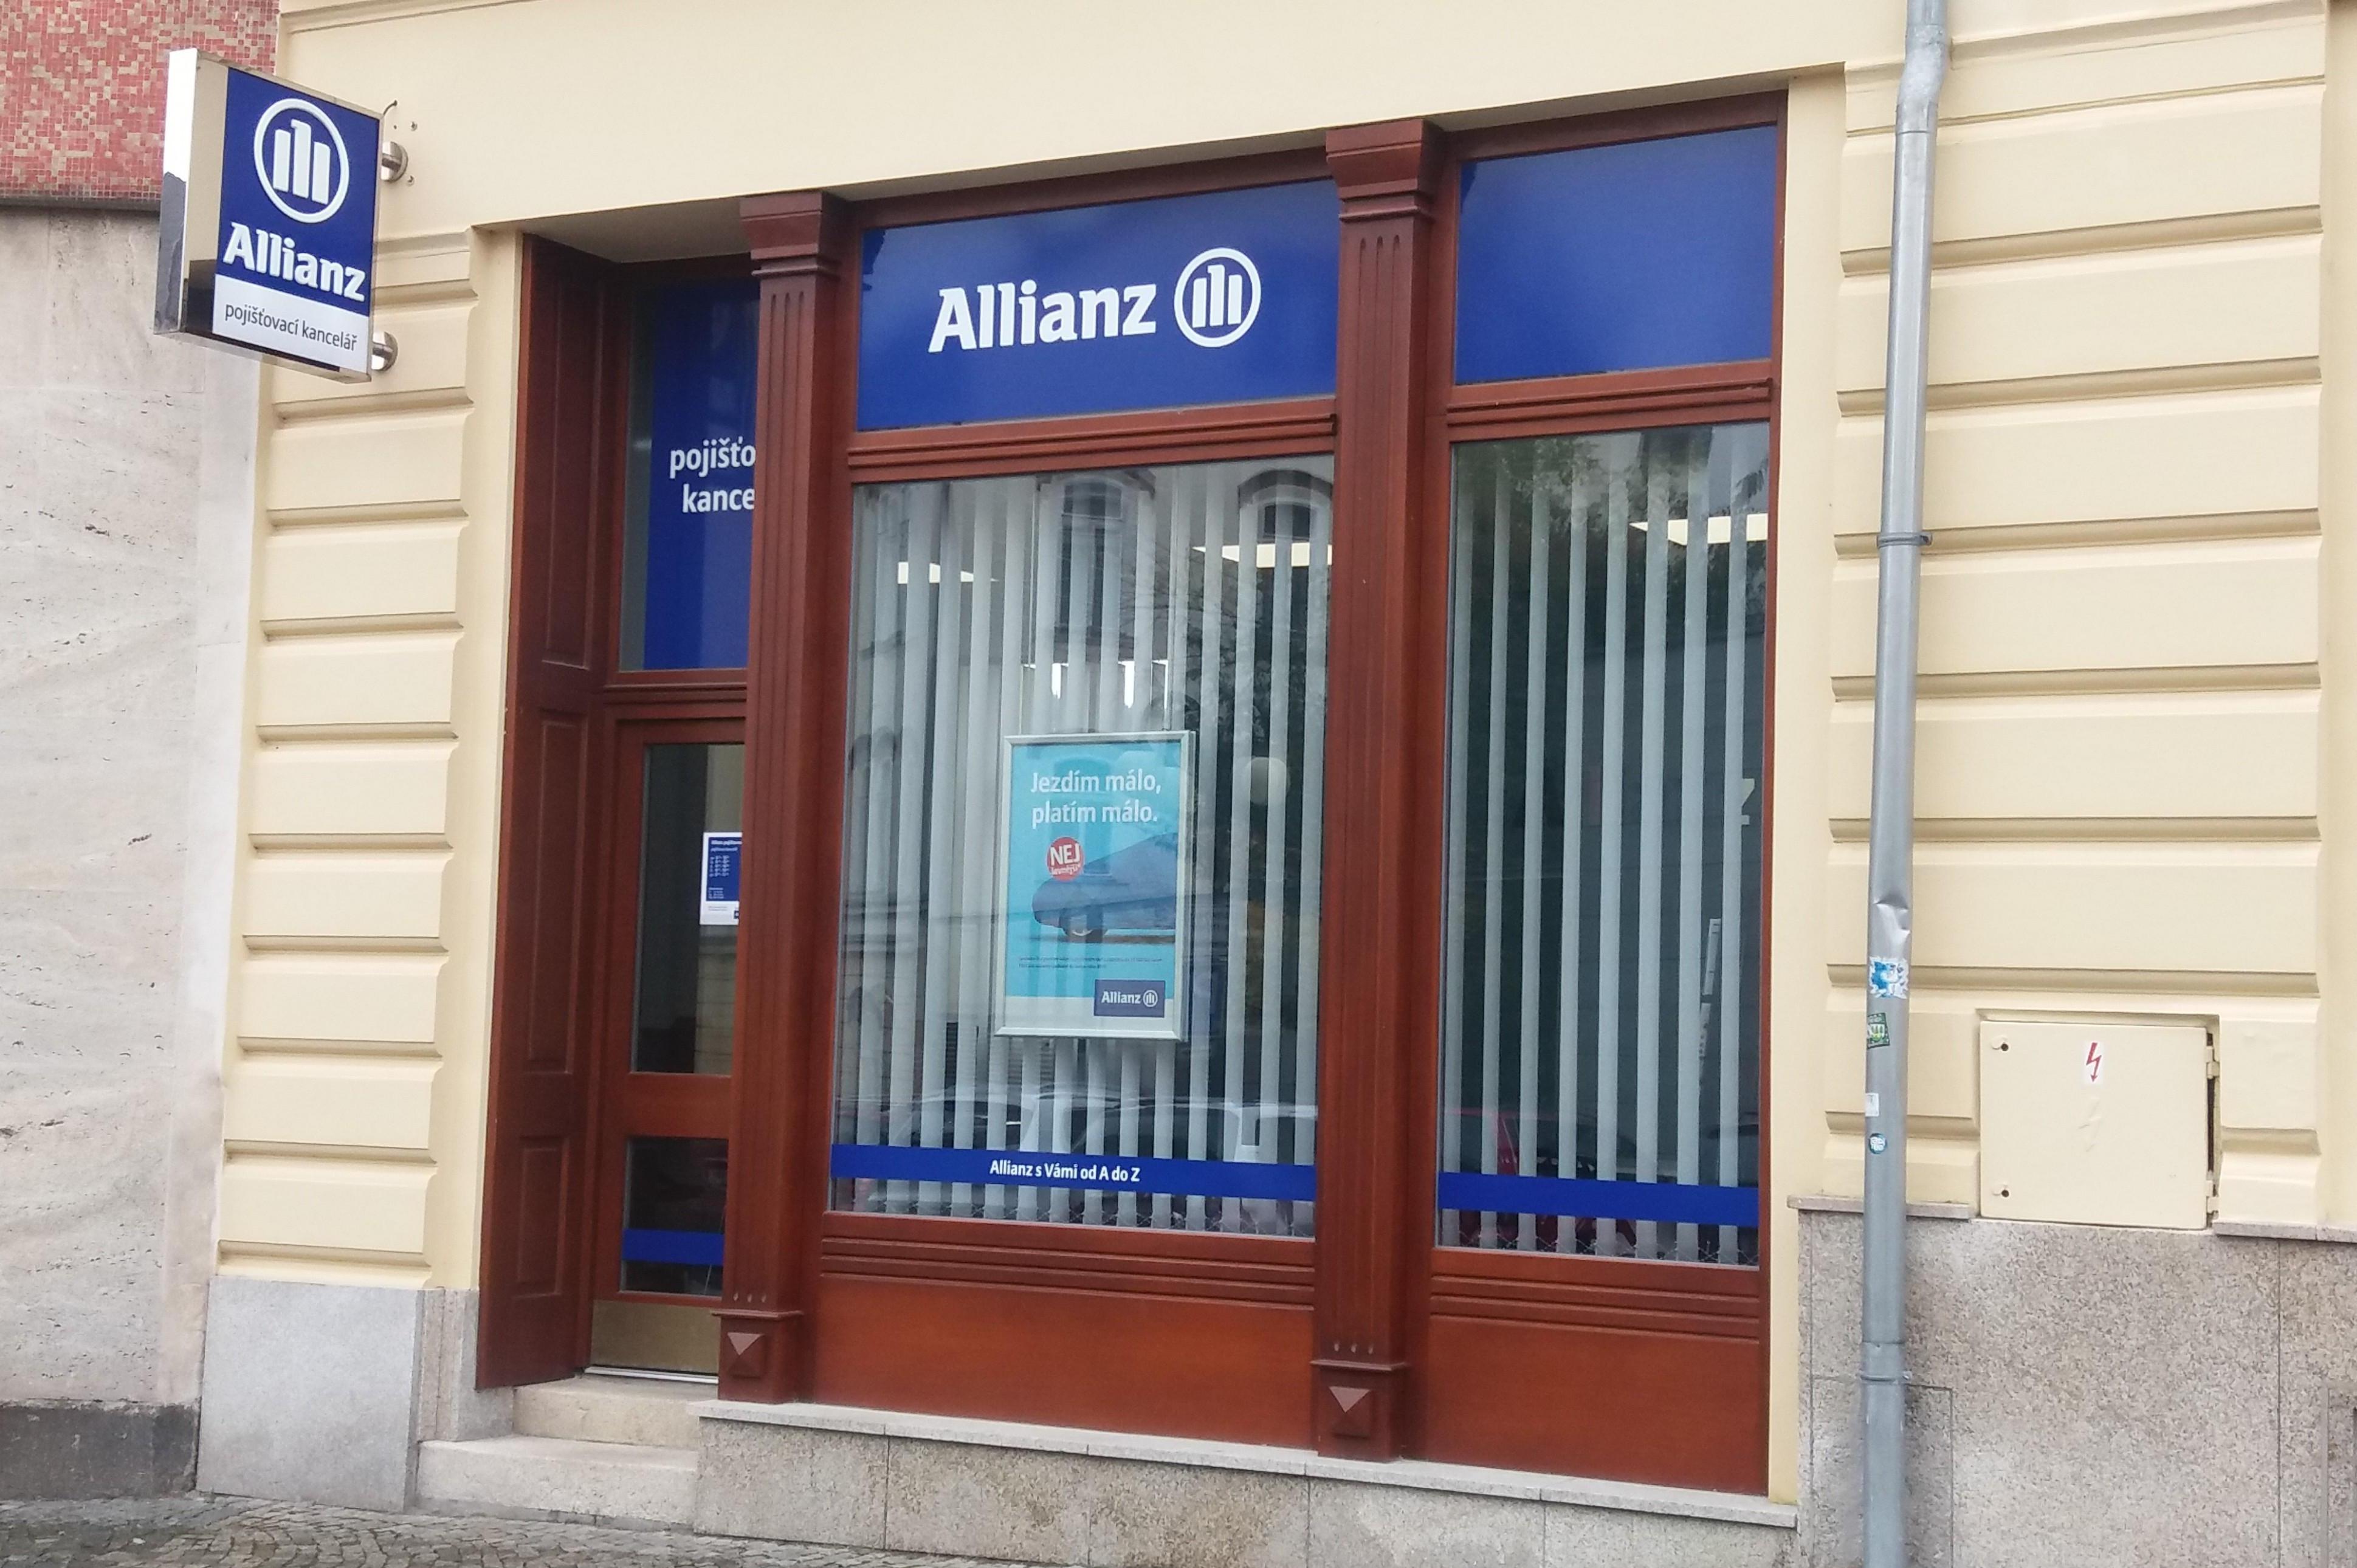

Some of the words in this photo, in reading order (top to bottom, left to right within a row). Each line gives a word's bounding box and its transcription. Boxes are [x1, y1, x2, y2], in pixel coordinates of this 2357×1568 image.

[222, 222, 366, 302] Allianz
[224, 304, 299, 335] pojišťovací
[302, 320, 358, 351] kancelář
[927, 279, 1157, 353] Allianz
[682, 483, 755, 513] kance
[1030, 769, 1099, 793] Jezdím
[1105, 768, 1161, 794] málo,
[1032, 800, 1096, 830] platím
[1101, 799, 1158, 822] málo.
[1050, 843, 1081, 866] NEJ
[1101, 991, 1141, 1004] Allianz
[989, 1159, 1033, 1177] Allianz
[1035, 1165, 1042, 1177] s
[1044, 1162, 1078, 1179] Vámi
[1080, 1164, 1097, 1180] od
[1099, 1166, 1109, 1181] A
[1111, 1165, 1129, 1181] do
[1130, 1167, 1141, 1182] Z
